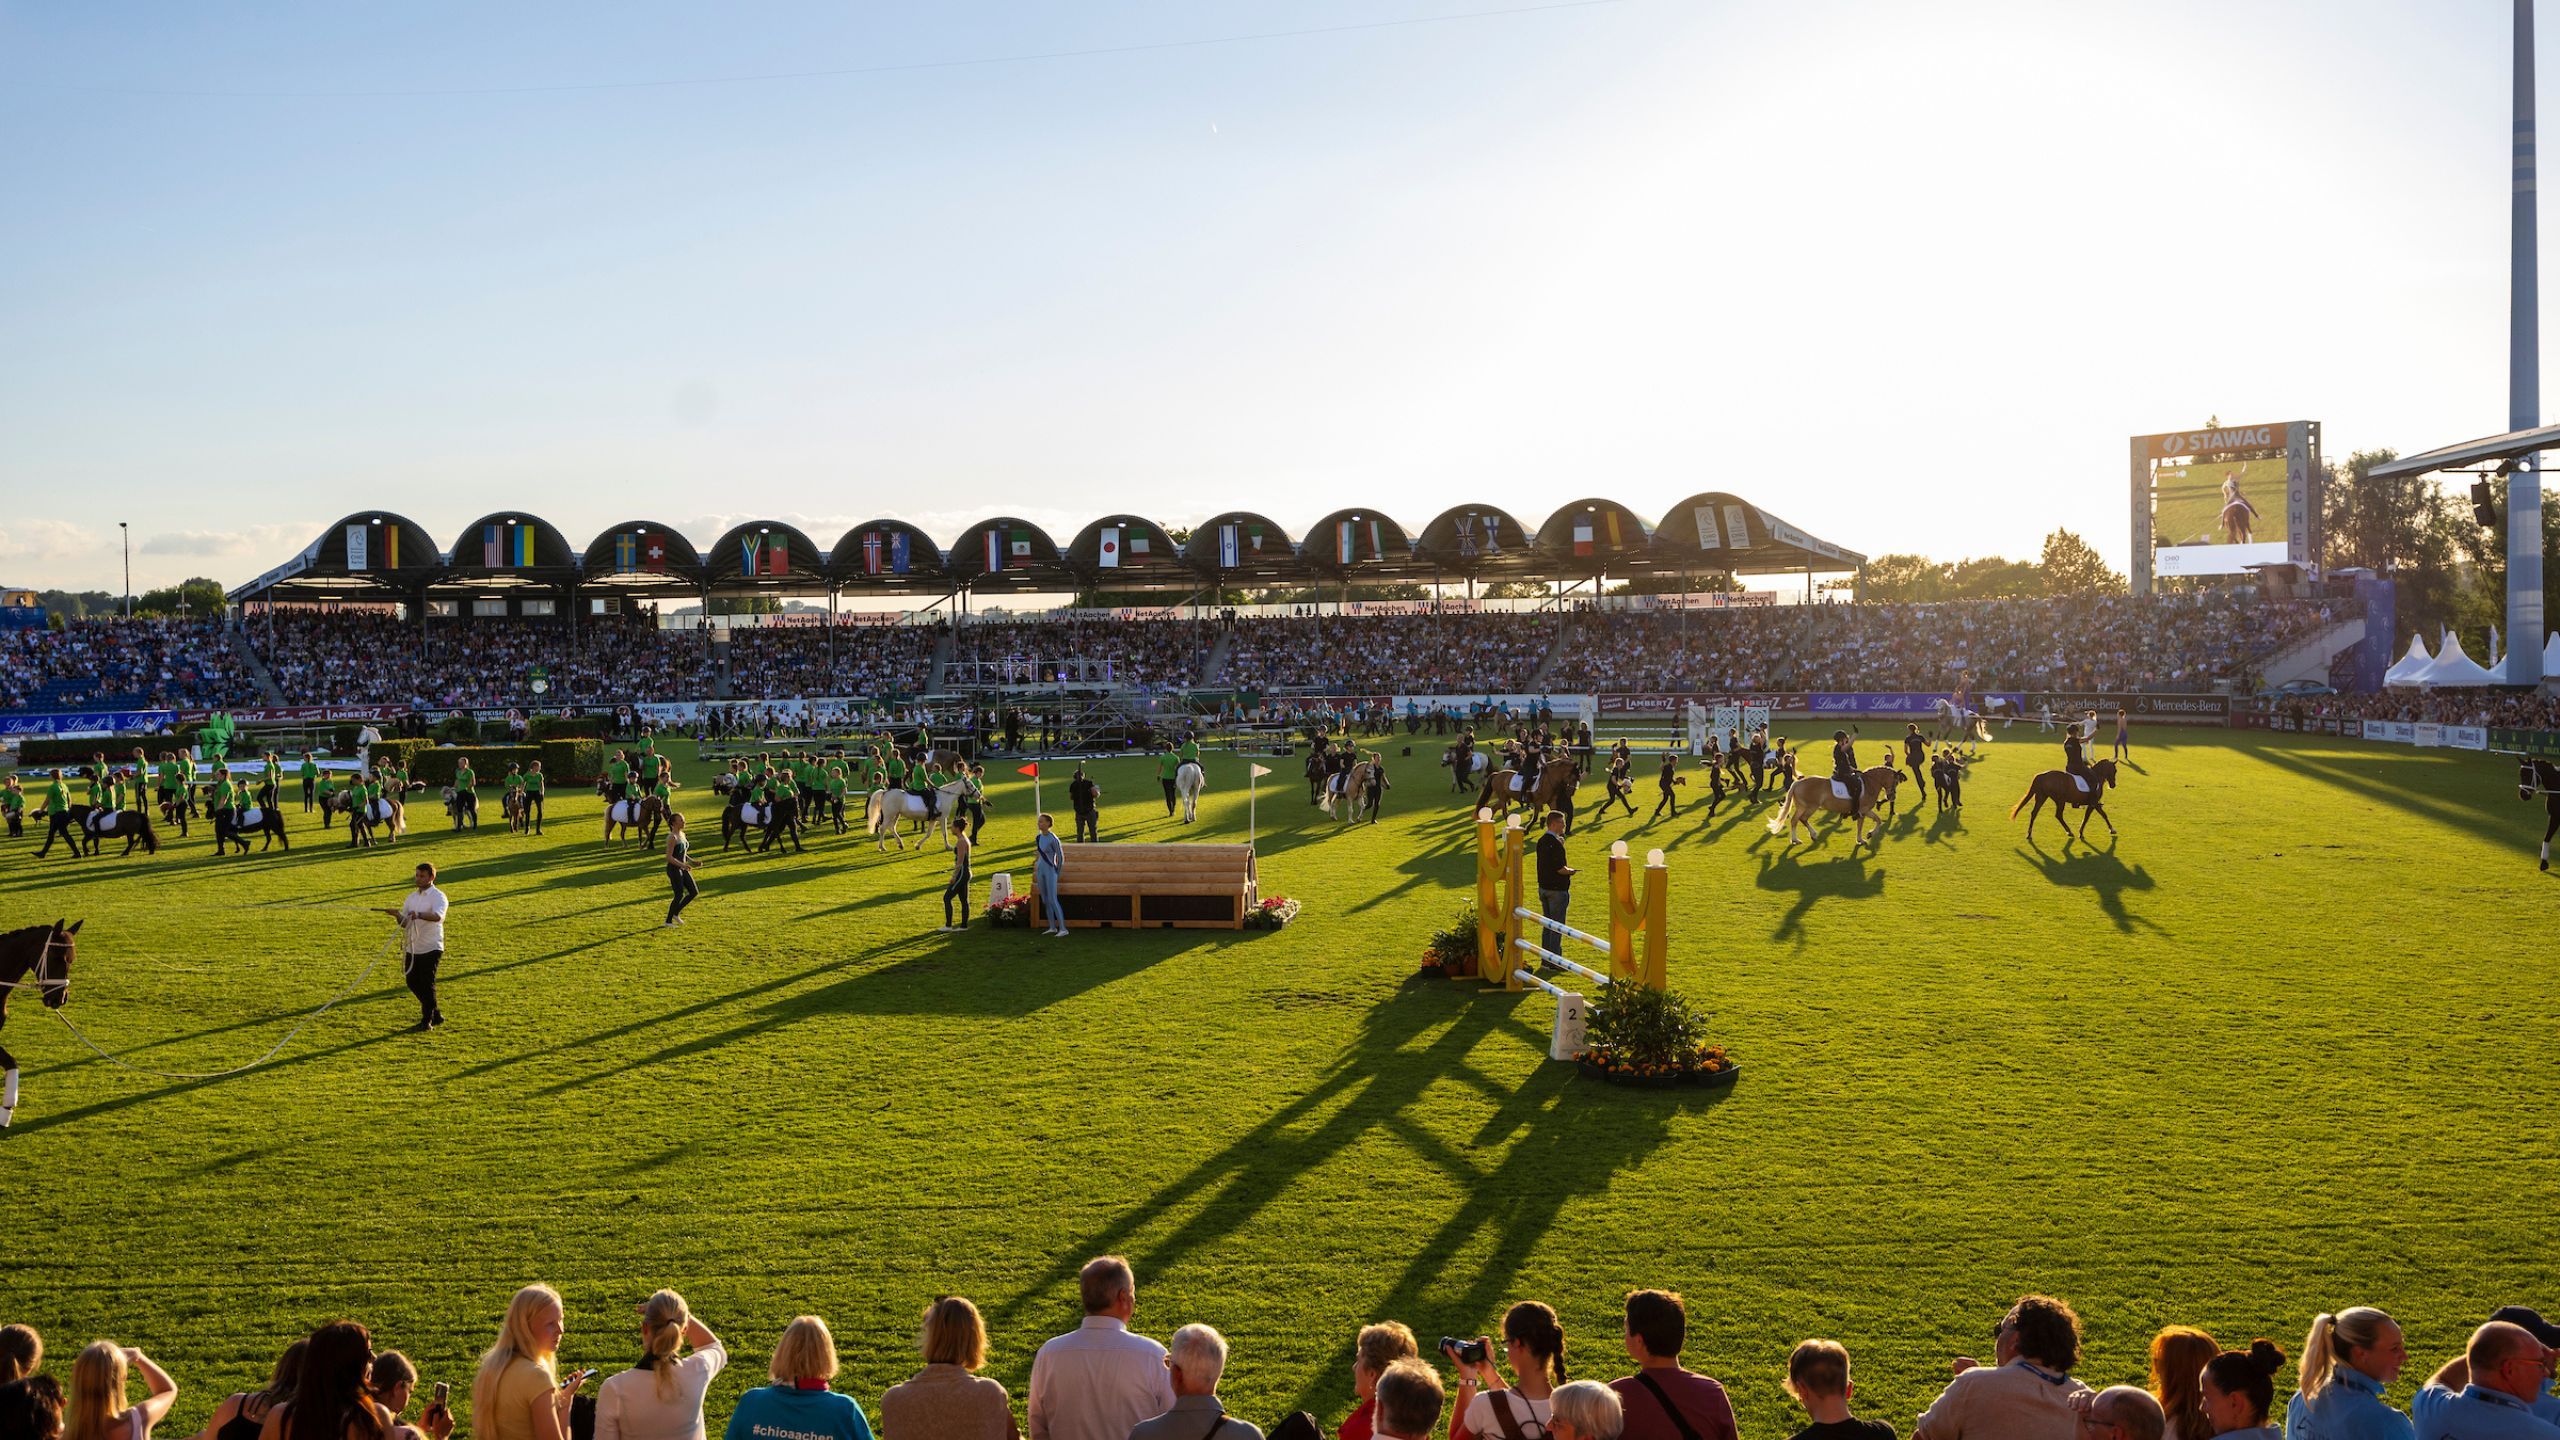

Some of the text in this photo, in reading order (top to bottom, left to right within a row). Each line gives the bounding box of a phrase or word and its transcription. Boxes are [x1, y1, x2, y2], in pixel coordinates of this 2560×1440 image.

[2188, 427, 2271, 452] STAWAG
[1365, 604, 1406, 612] NetAachen
[1626, 697, 1676, 711] LAMBERTZ
[1815, 697, 1852, 711] Lindt
[1869, 697, 1906, 711] Lindt
[2152, 700, 2222, 713] Mercedes-Benz
[327, 708, 383, 721] LAMBERTZ
[3, 718, 45, 734] Lindt
[64, 716, 106, 732] Lindt
[996, 882, 1002, 891] 3
[1568, 1008, 1577, 1021] 2
